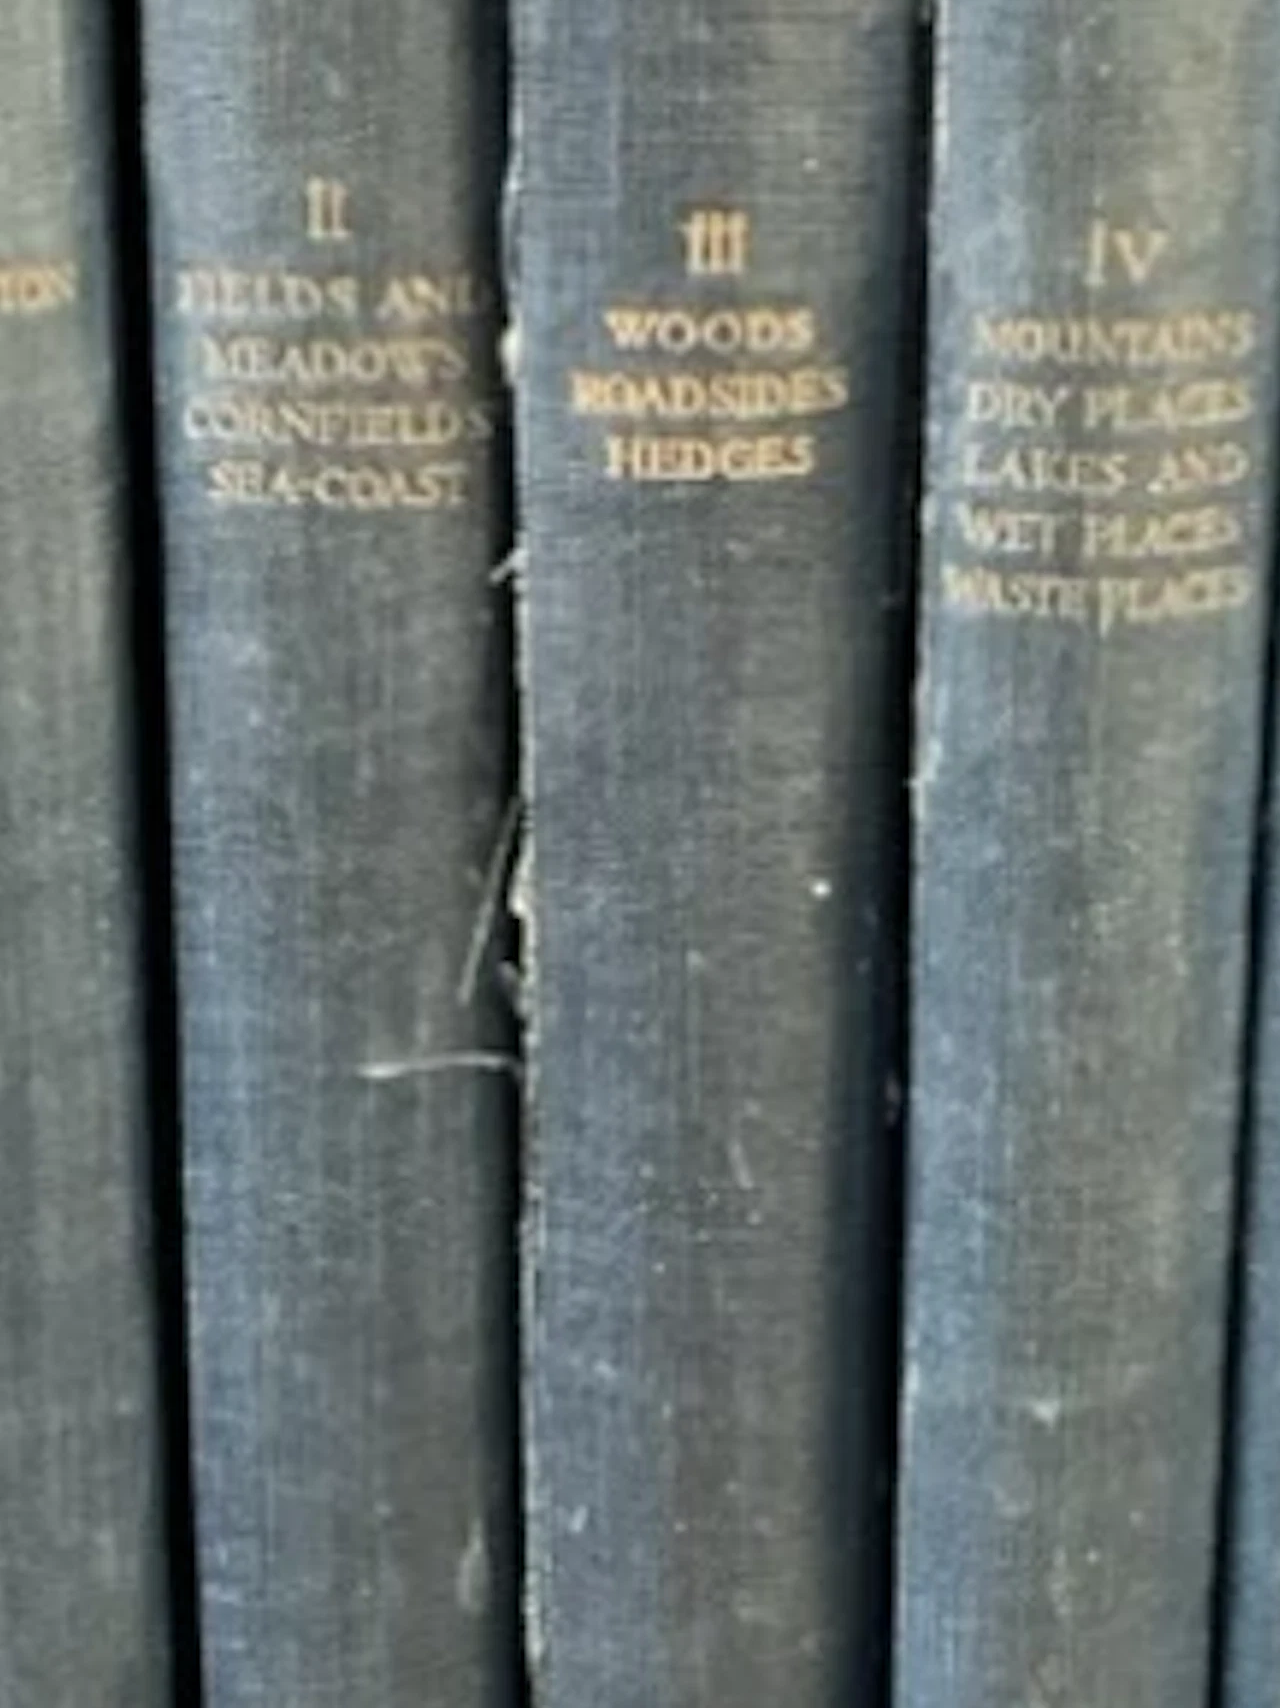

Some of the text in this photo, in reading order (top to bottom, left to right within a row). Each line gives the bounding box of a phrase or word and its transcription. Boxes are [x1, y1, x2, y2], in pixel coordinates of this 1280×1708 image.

[1084, 218, 1165, 286] IV
[605, 310, 813, 352] WOODS
[570, 369, 848, 418] ROADSIDES
[966, 381, 1067, 429] DRY
[606, 436, 814, 481] HEDGES
[962, 442, 1126, 493] LAKES
